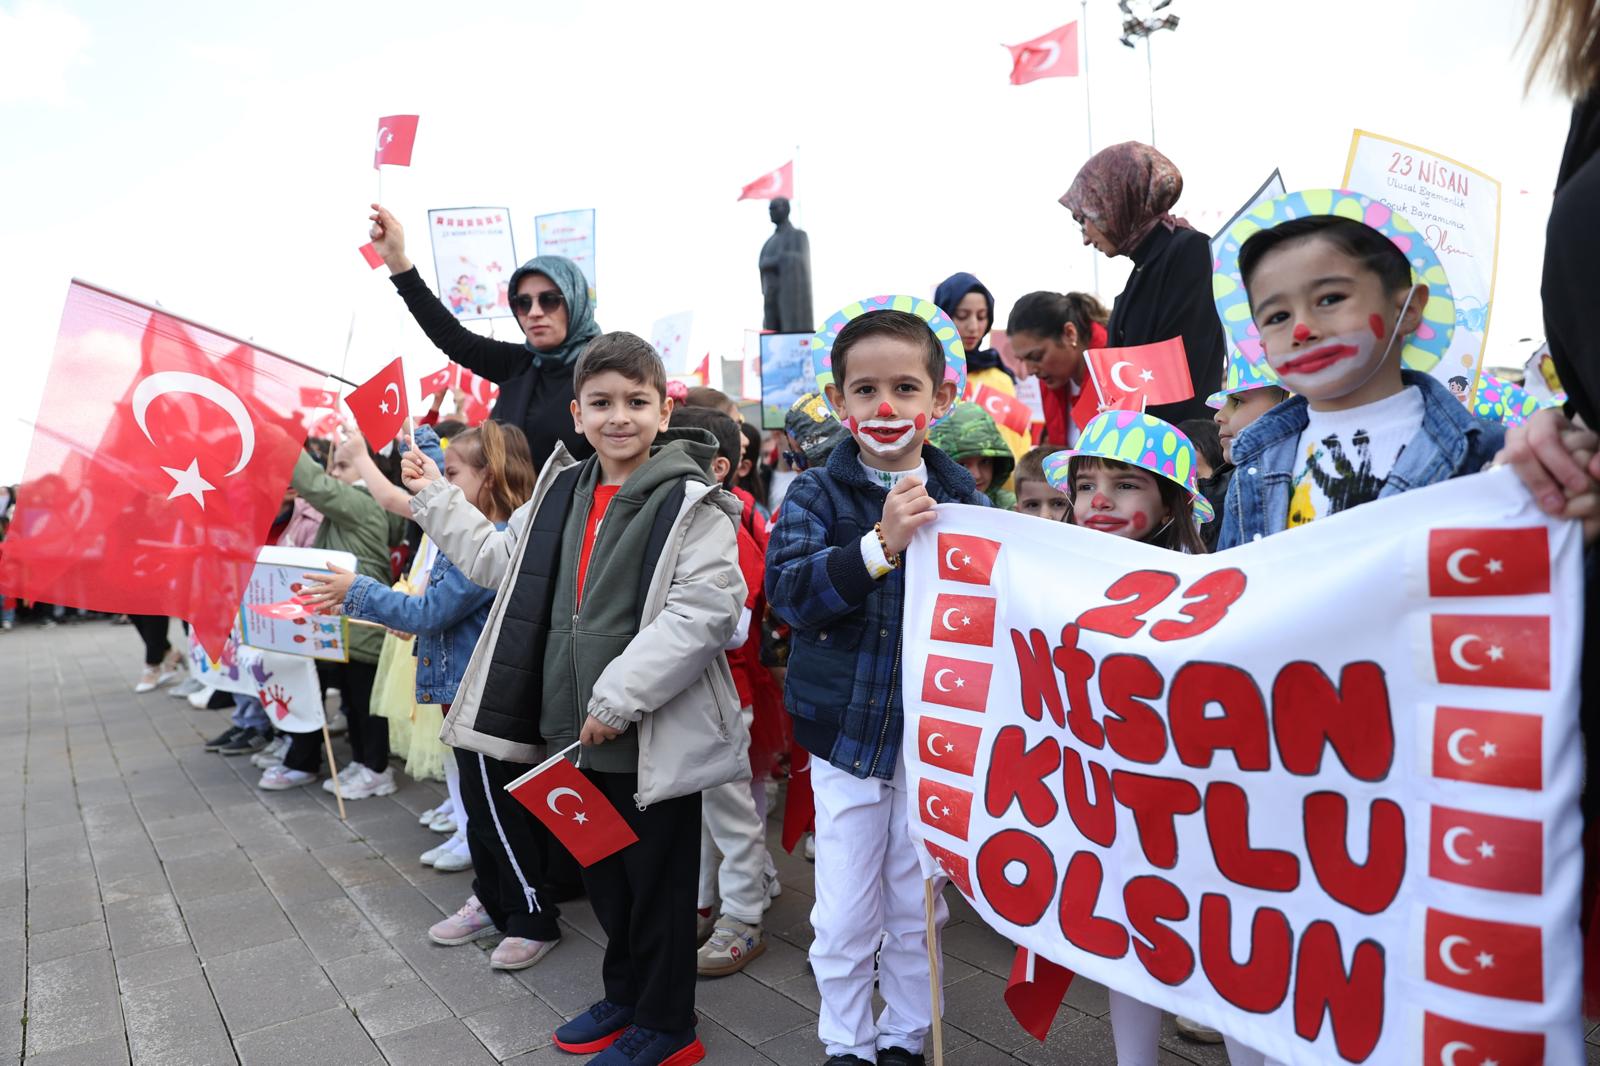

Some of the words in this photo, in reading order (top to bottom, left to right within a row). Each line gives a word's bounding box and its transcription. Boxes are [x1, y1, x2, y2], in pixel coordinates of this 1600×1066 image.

[1387, 176, 1417, 193] Ulusal
[1388, 152, 1413, 176] 23
[1418, 159, 1469, 197] NİSAN
[1420, 200, 1431, 208] ve
[1075, 567, 1248, 642] 23
[1009, 621, 1396, 783] NİSAN
[984, 724, 1407, 916] KUTLU
[975, 828, 1386, 1064] OLSUN
